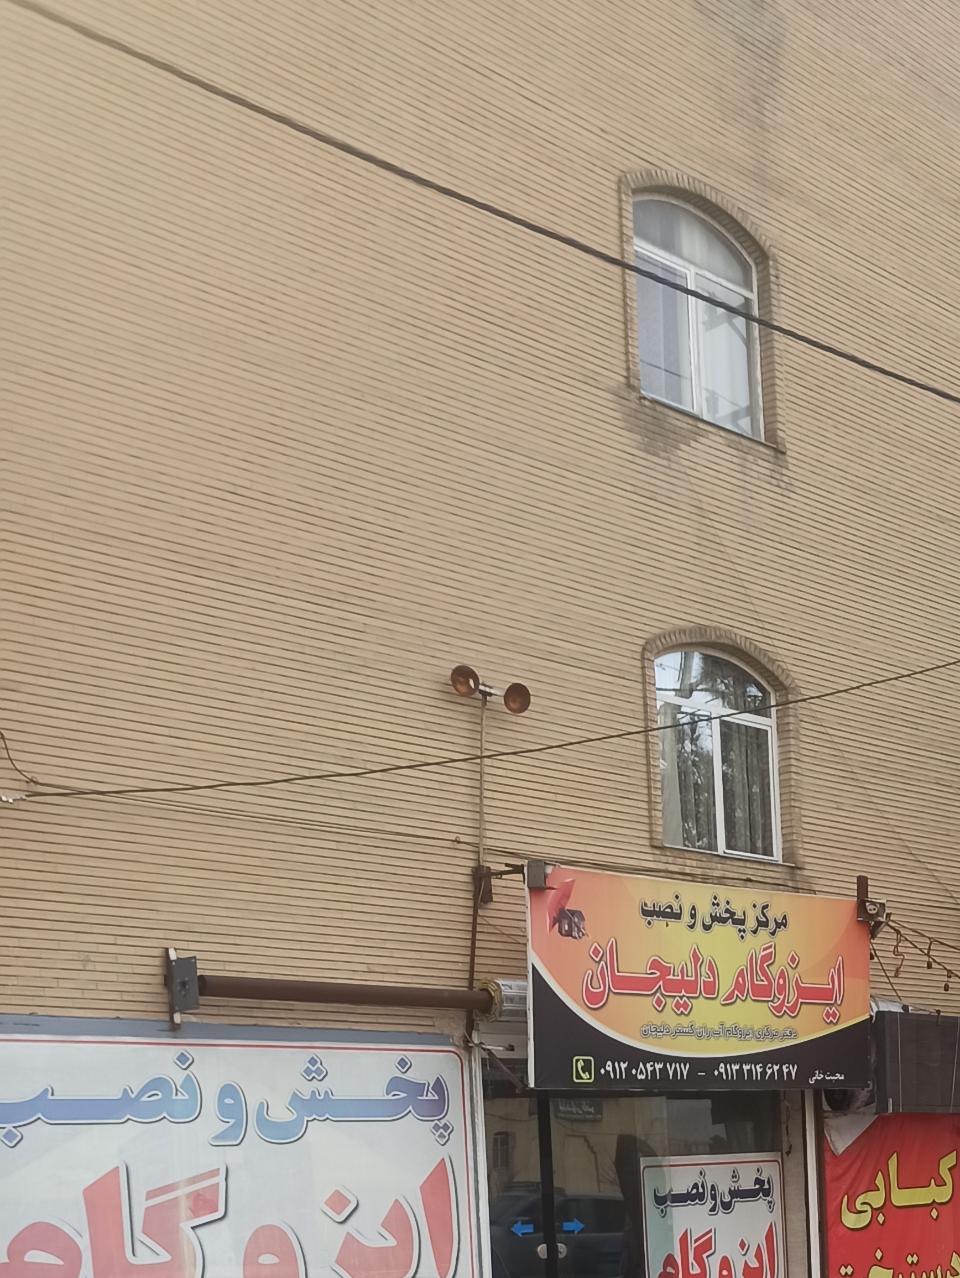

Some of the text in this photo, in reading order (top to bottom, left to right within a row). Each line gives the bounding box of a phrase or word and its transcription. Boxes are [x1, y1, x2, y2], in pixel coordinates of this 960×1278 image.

[640, 893, 788, 941] مرکز پخش و نصب
[582, 937, 844, 1024] ایزوگام دلیجان
[0, 1050, 449, 1147] پخش و نصب
[808, 1069, 845, 1084] محبت خانی
[653, 1168, 775, 1217] پخش و نصب
[840, 1149, 958, 1230] کبابی
